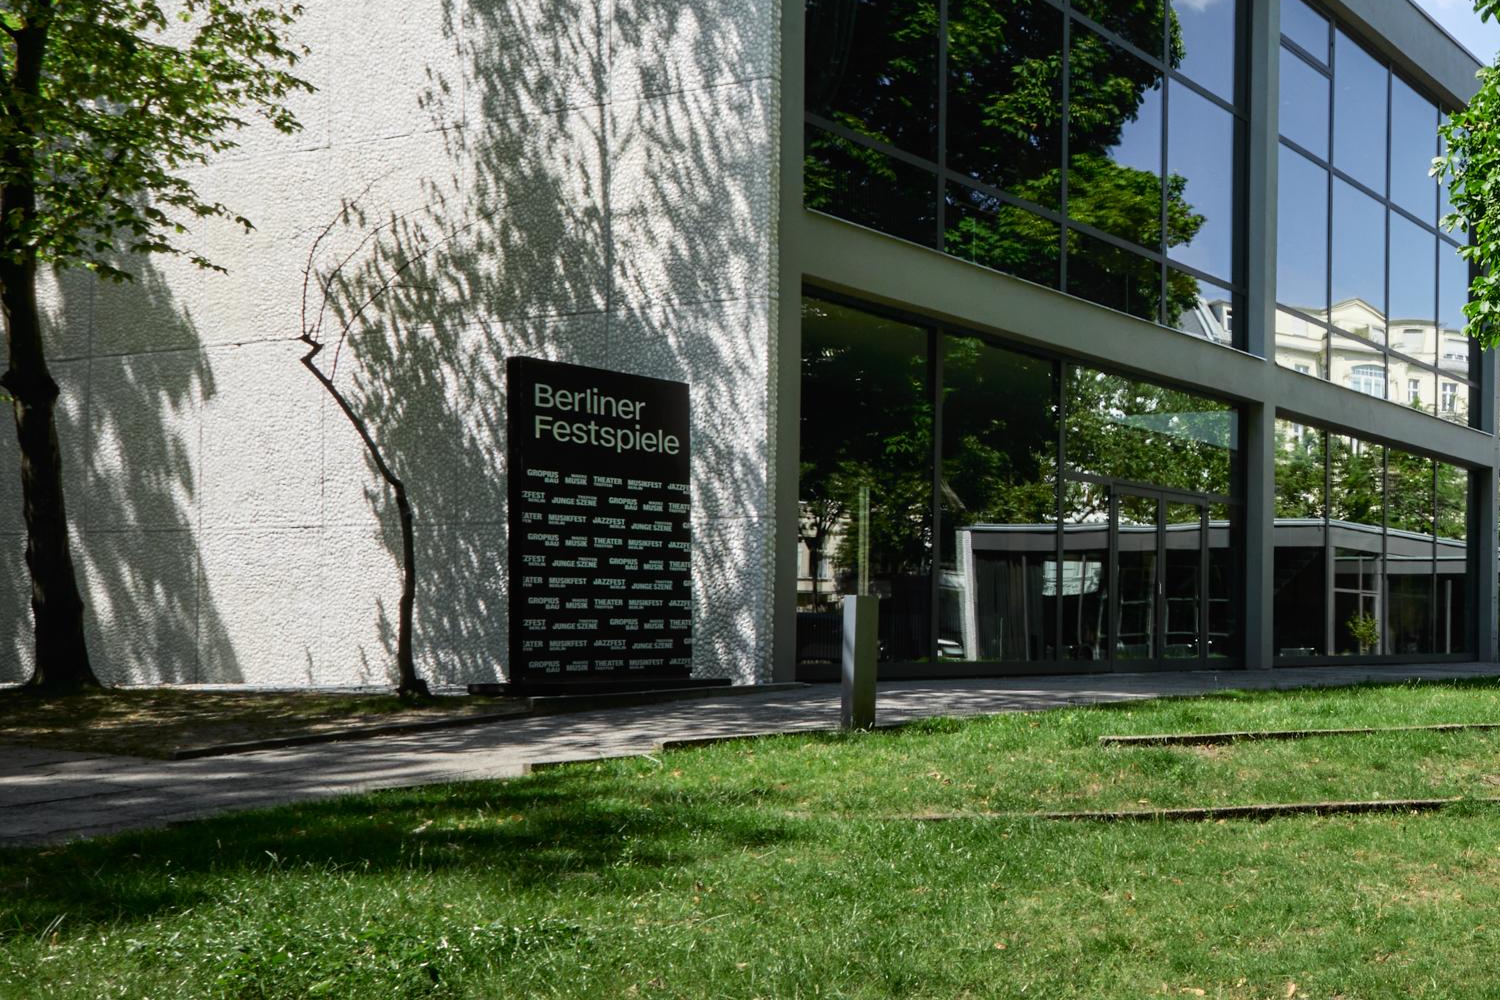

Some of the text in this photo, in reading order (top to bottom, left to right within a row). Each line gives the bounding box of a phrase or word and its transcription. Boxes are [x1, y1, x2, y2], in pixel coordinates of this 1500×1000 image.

[534, 383, 646, 420] Berliner
[535, 415, 680, 455] Festspiele
[527, 469, 559, 478] GROPIUS
[565, 477, 587, 485] MUSIK
[593, 476, 622, 484] THEATER
[628, 480, 662, 489] MUSIKFEST
[552, 496, 597, 506] JUNGE SZENE
[608, 497, 637, 506] GROPIUS
[548, 514, 587, 523] MUSIKFEST
[593, 517, 625, 525] JAZZFEST
[631, 523, 651, 531] JUNGE
[528, 533, 559, 541] GROPIUS
[628, 539, 662, 547] MUSIKFEST
